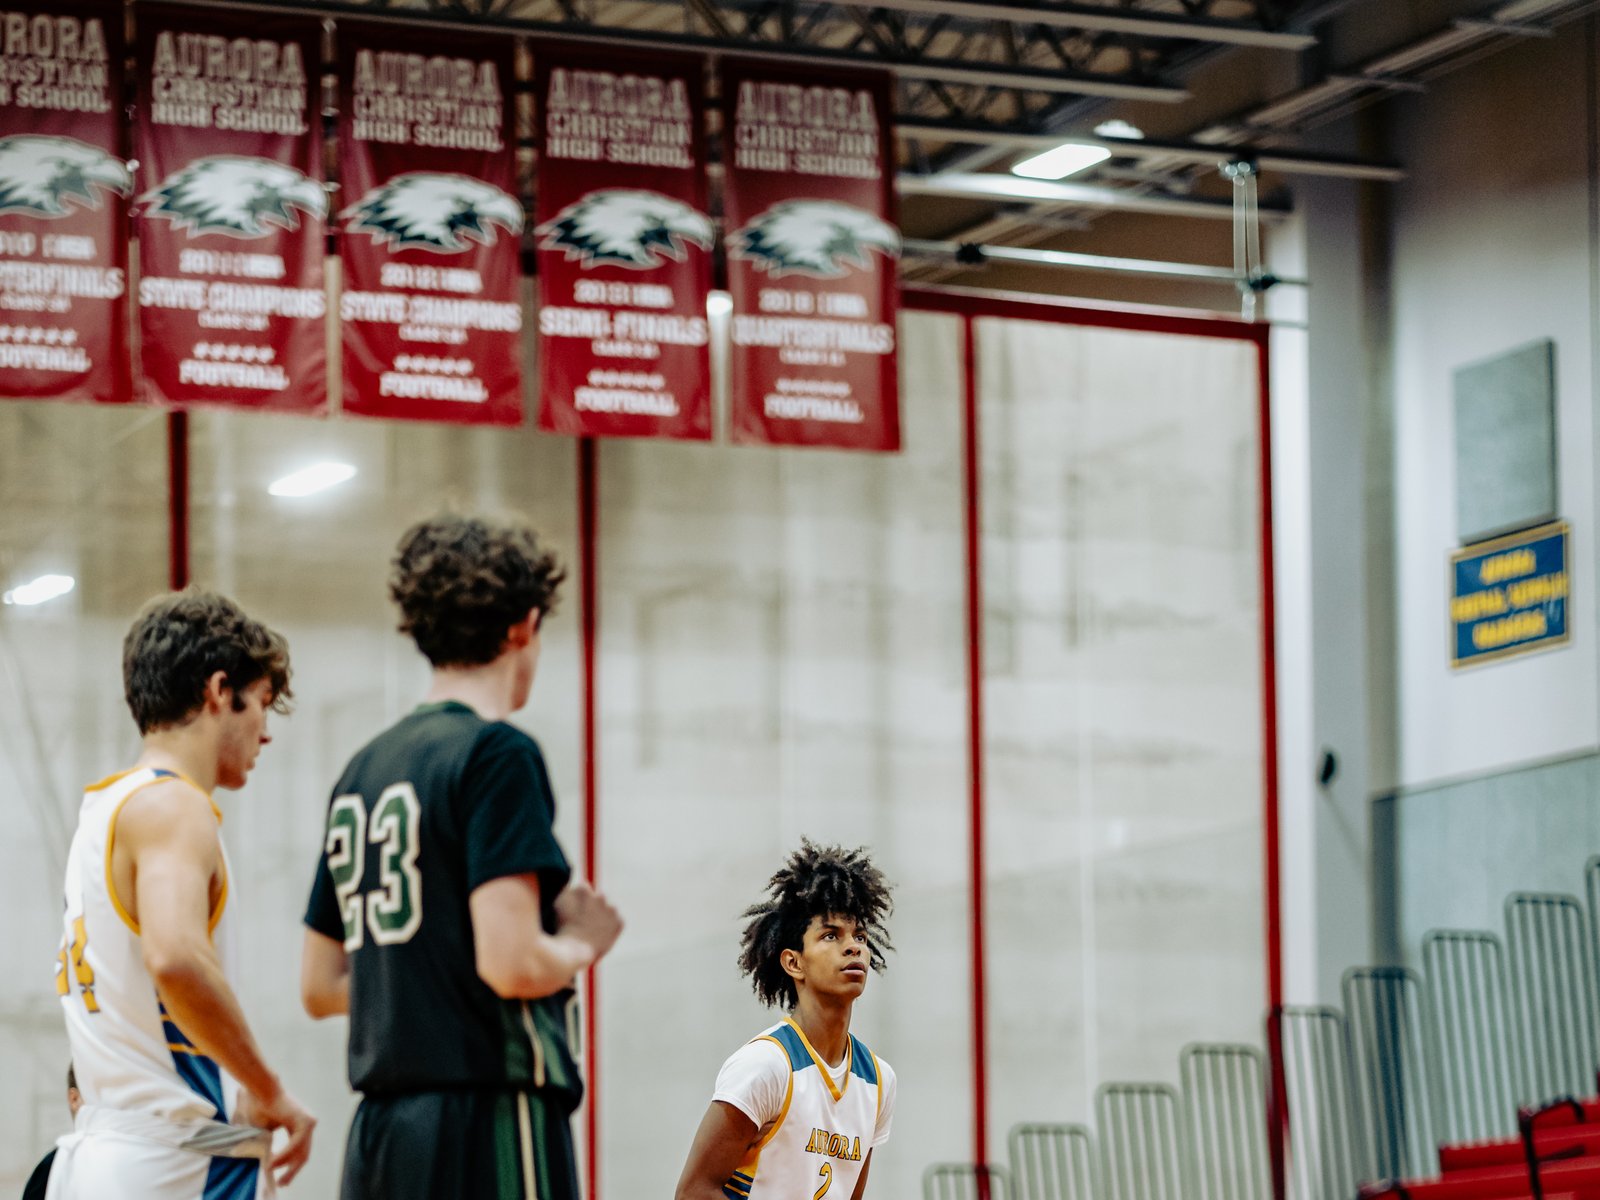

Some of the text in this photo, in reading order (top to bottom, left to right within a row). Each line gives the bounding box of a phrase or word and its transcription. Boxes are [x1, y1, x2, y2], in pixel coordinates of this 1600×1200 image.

[153, 30, 308, 83] AURORA
[214, 106, 309, 135] SCHOOL
[325, 782, 423, 952] 23
